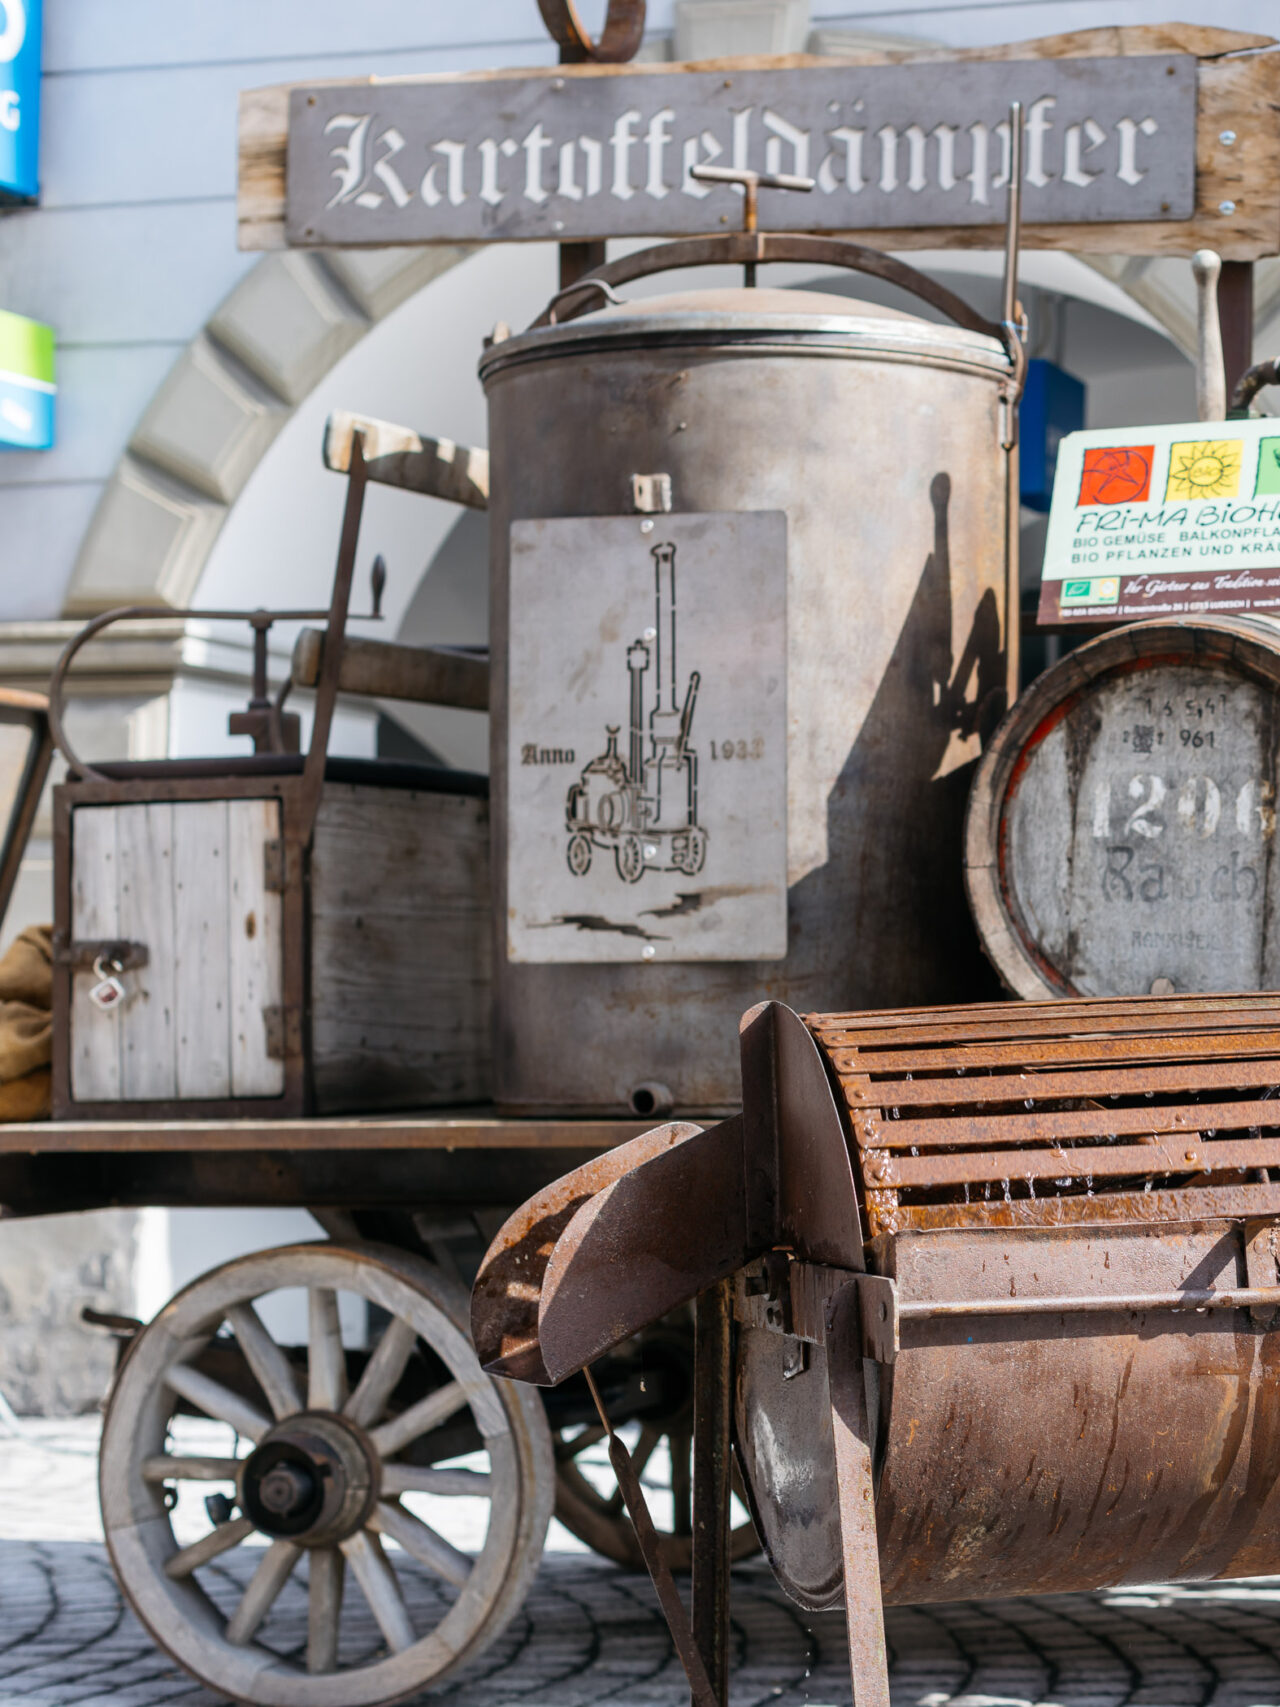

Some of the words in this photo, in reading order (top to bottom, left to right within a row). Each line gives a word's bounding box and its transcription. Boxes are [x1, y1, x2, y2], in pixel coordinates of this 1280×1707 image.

[324, 95, 1160, 209] Kartoffeldämpfer
[1073, 537, 1098, 548] BIO
[1103, 532, 1166, 547] GEMÜSE
[1071, 552, 1099, 564] BIO
[1106, 546, 1192, 561] PFLANZEN
[1200, 544, 1234, 556] UND
[521, 742, 575, 765] Anno
